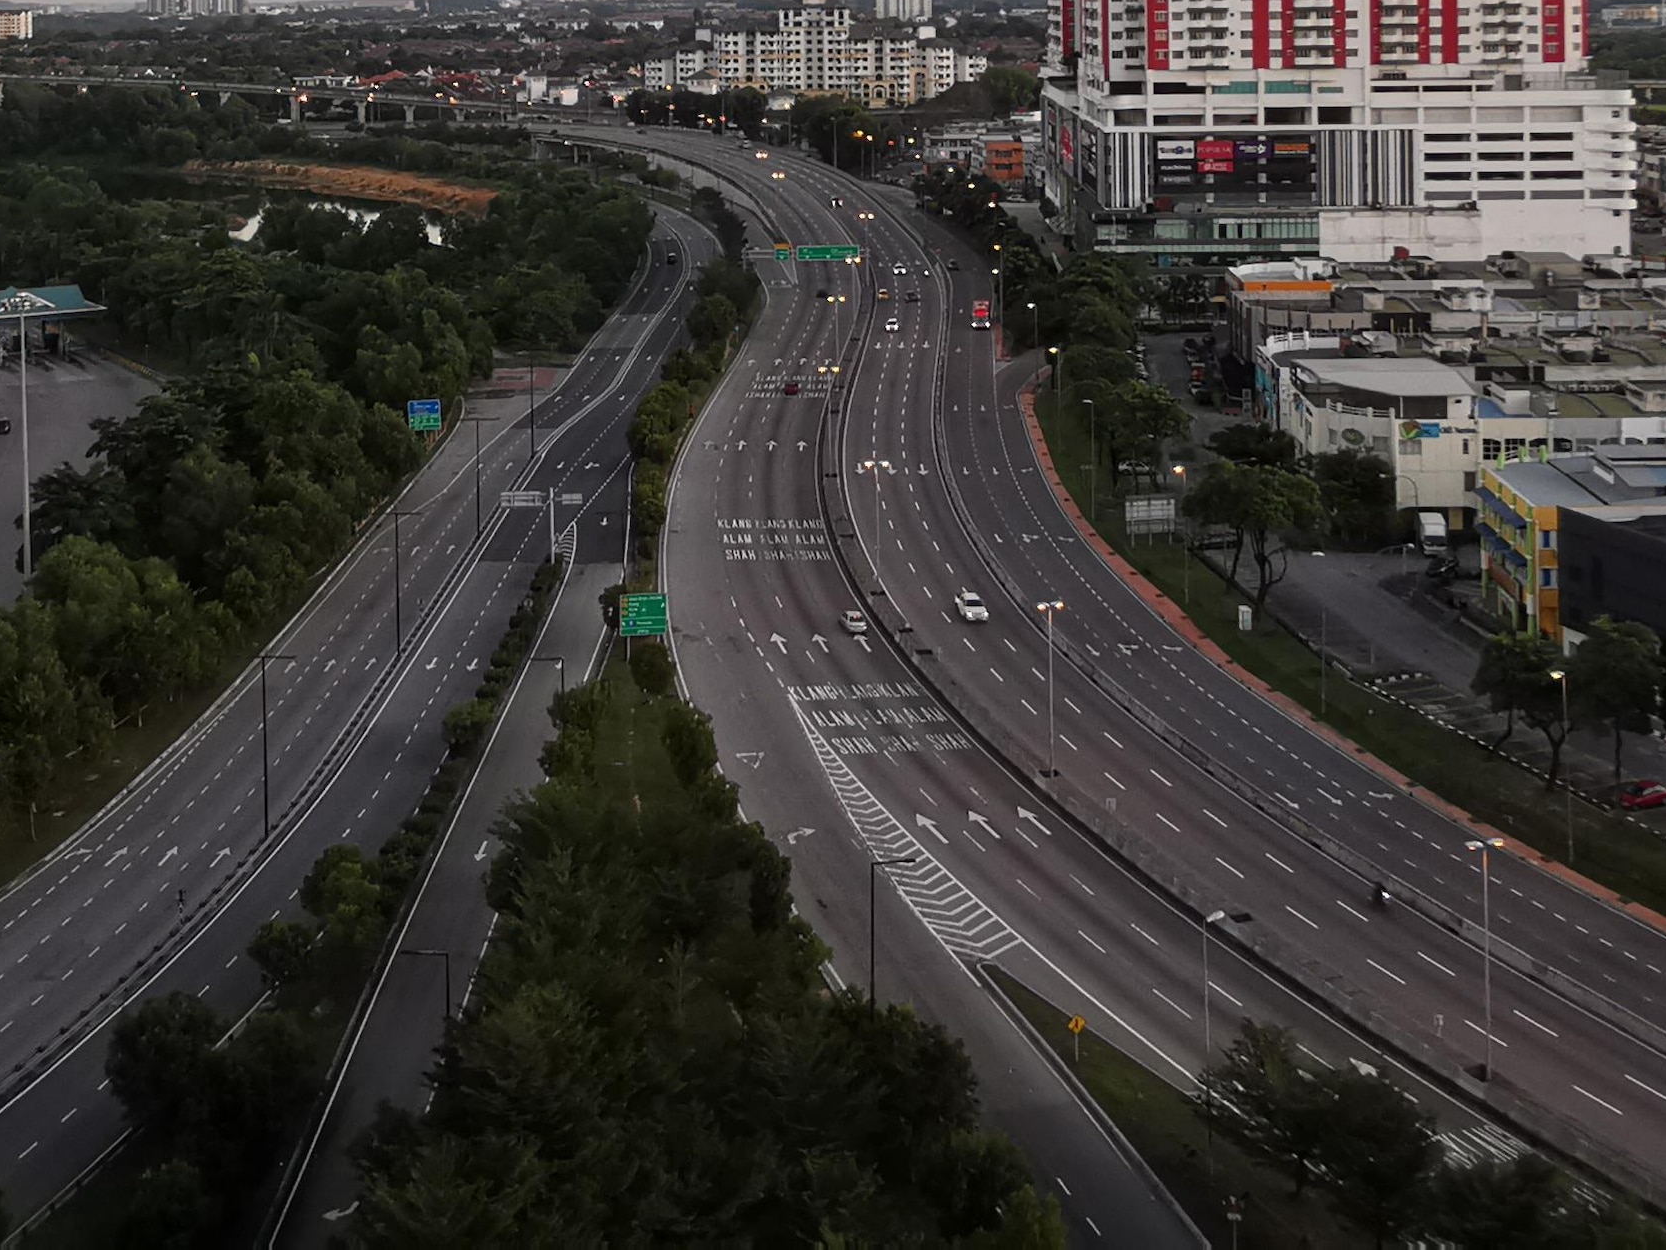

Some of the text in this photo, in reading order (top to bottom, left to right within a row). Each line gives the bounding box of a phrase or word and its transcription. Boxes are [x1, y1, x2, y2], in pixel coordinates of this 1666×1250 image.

[717, 519, 751, 529] KLANG
[723, 534, 752, 544] ALAM
[796, 534, 825, 544] ALAM
[725, 549, 756, 561] SHAH
[799, 550, 831, 561] SHAH
[787, 684, 837, 701] KLANG
[811, 709, 856, 728] ALAM
[902, 707, 948, 724] ALAM
[831, 737, 878, 755] SHAH
[925, 733, 973, 751] SHAH
